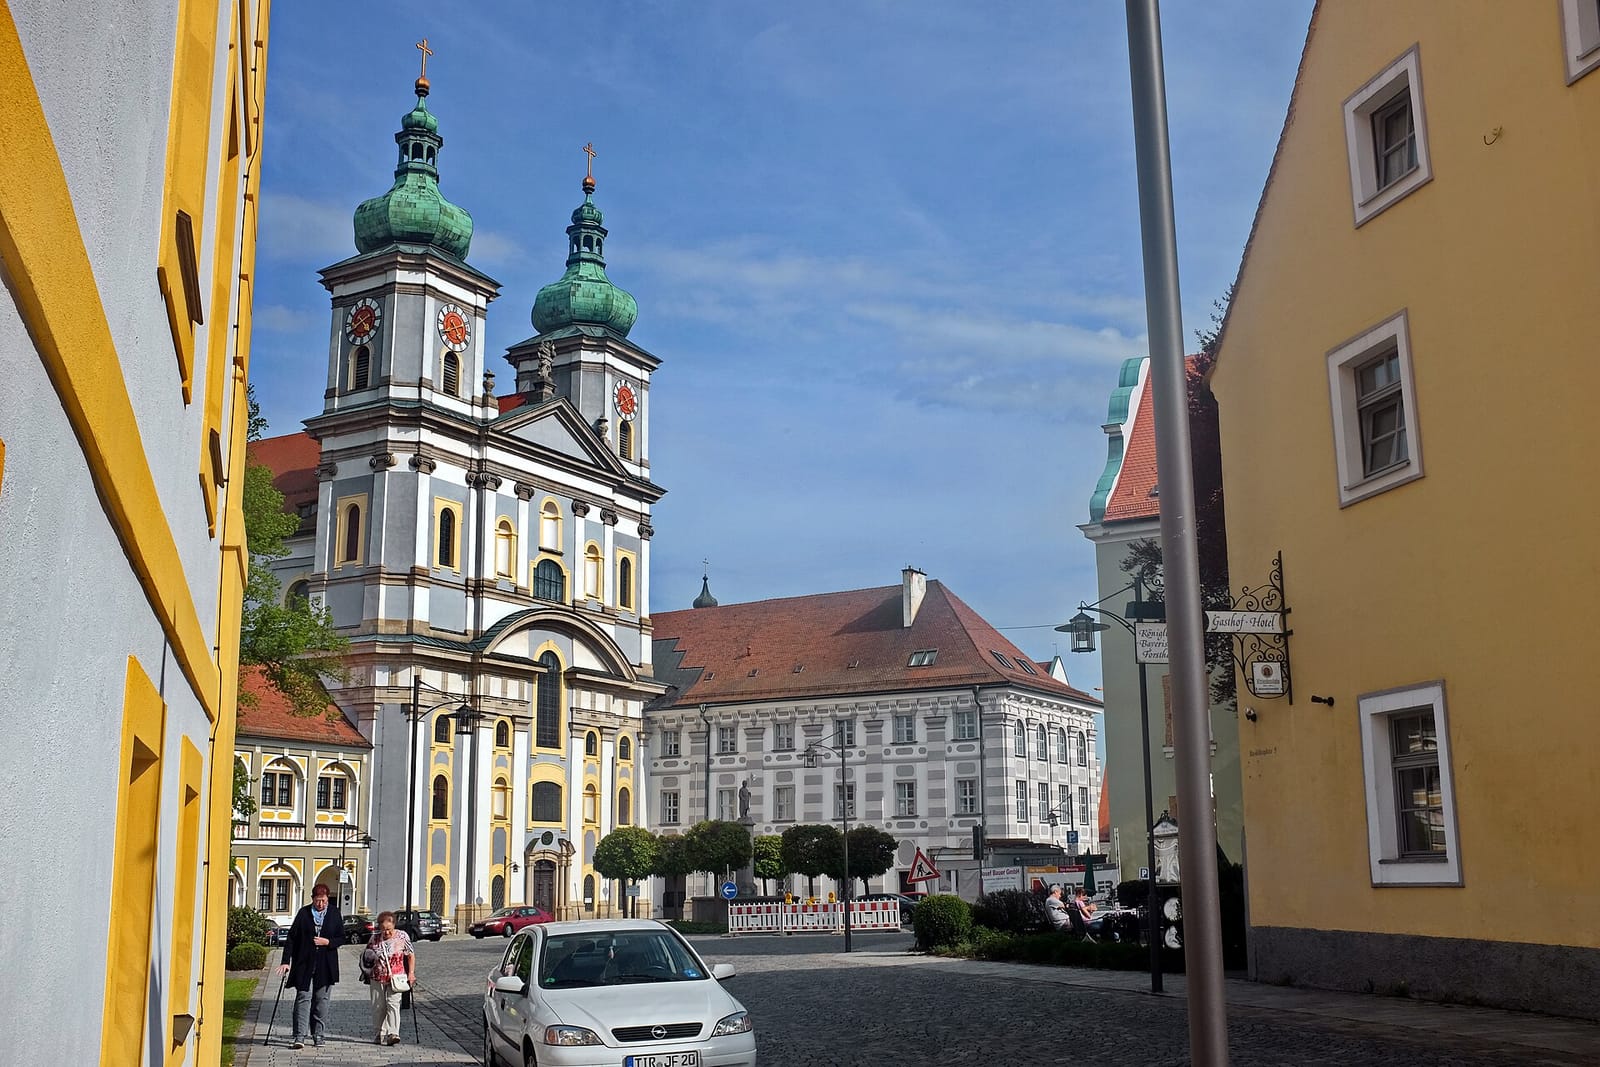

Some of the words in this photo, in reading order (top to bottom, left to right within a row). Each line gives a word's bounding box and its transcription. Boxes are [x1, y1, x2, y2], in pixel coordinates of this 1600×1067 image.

[1211, 613, 1246, 631] Gasthof
[1250, 613, 1277, 630] Hotel
[635, 1057, 656, 1067] TIR
[664, 1055, 679, 1067] JF
[681, 1054, 696, 1066] 20
